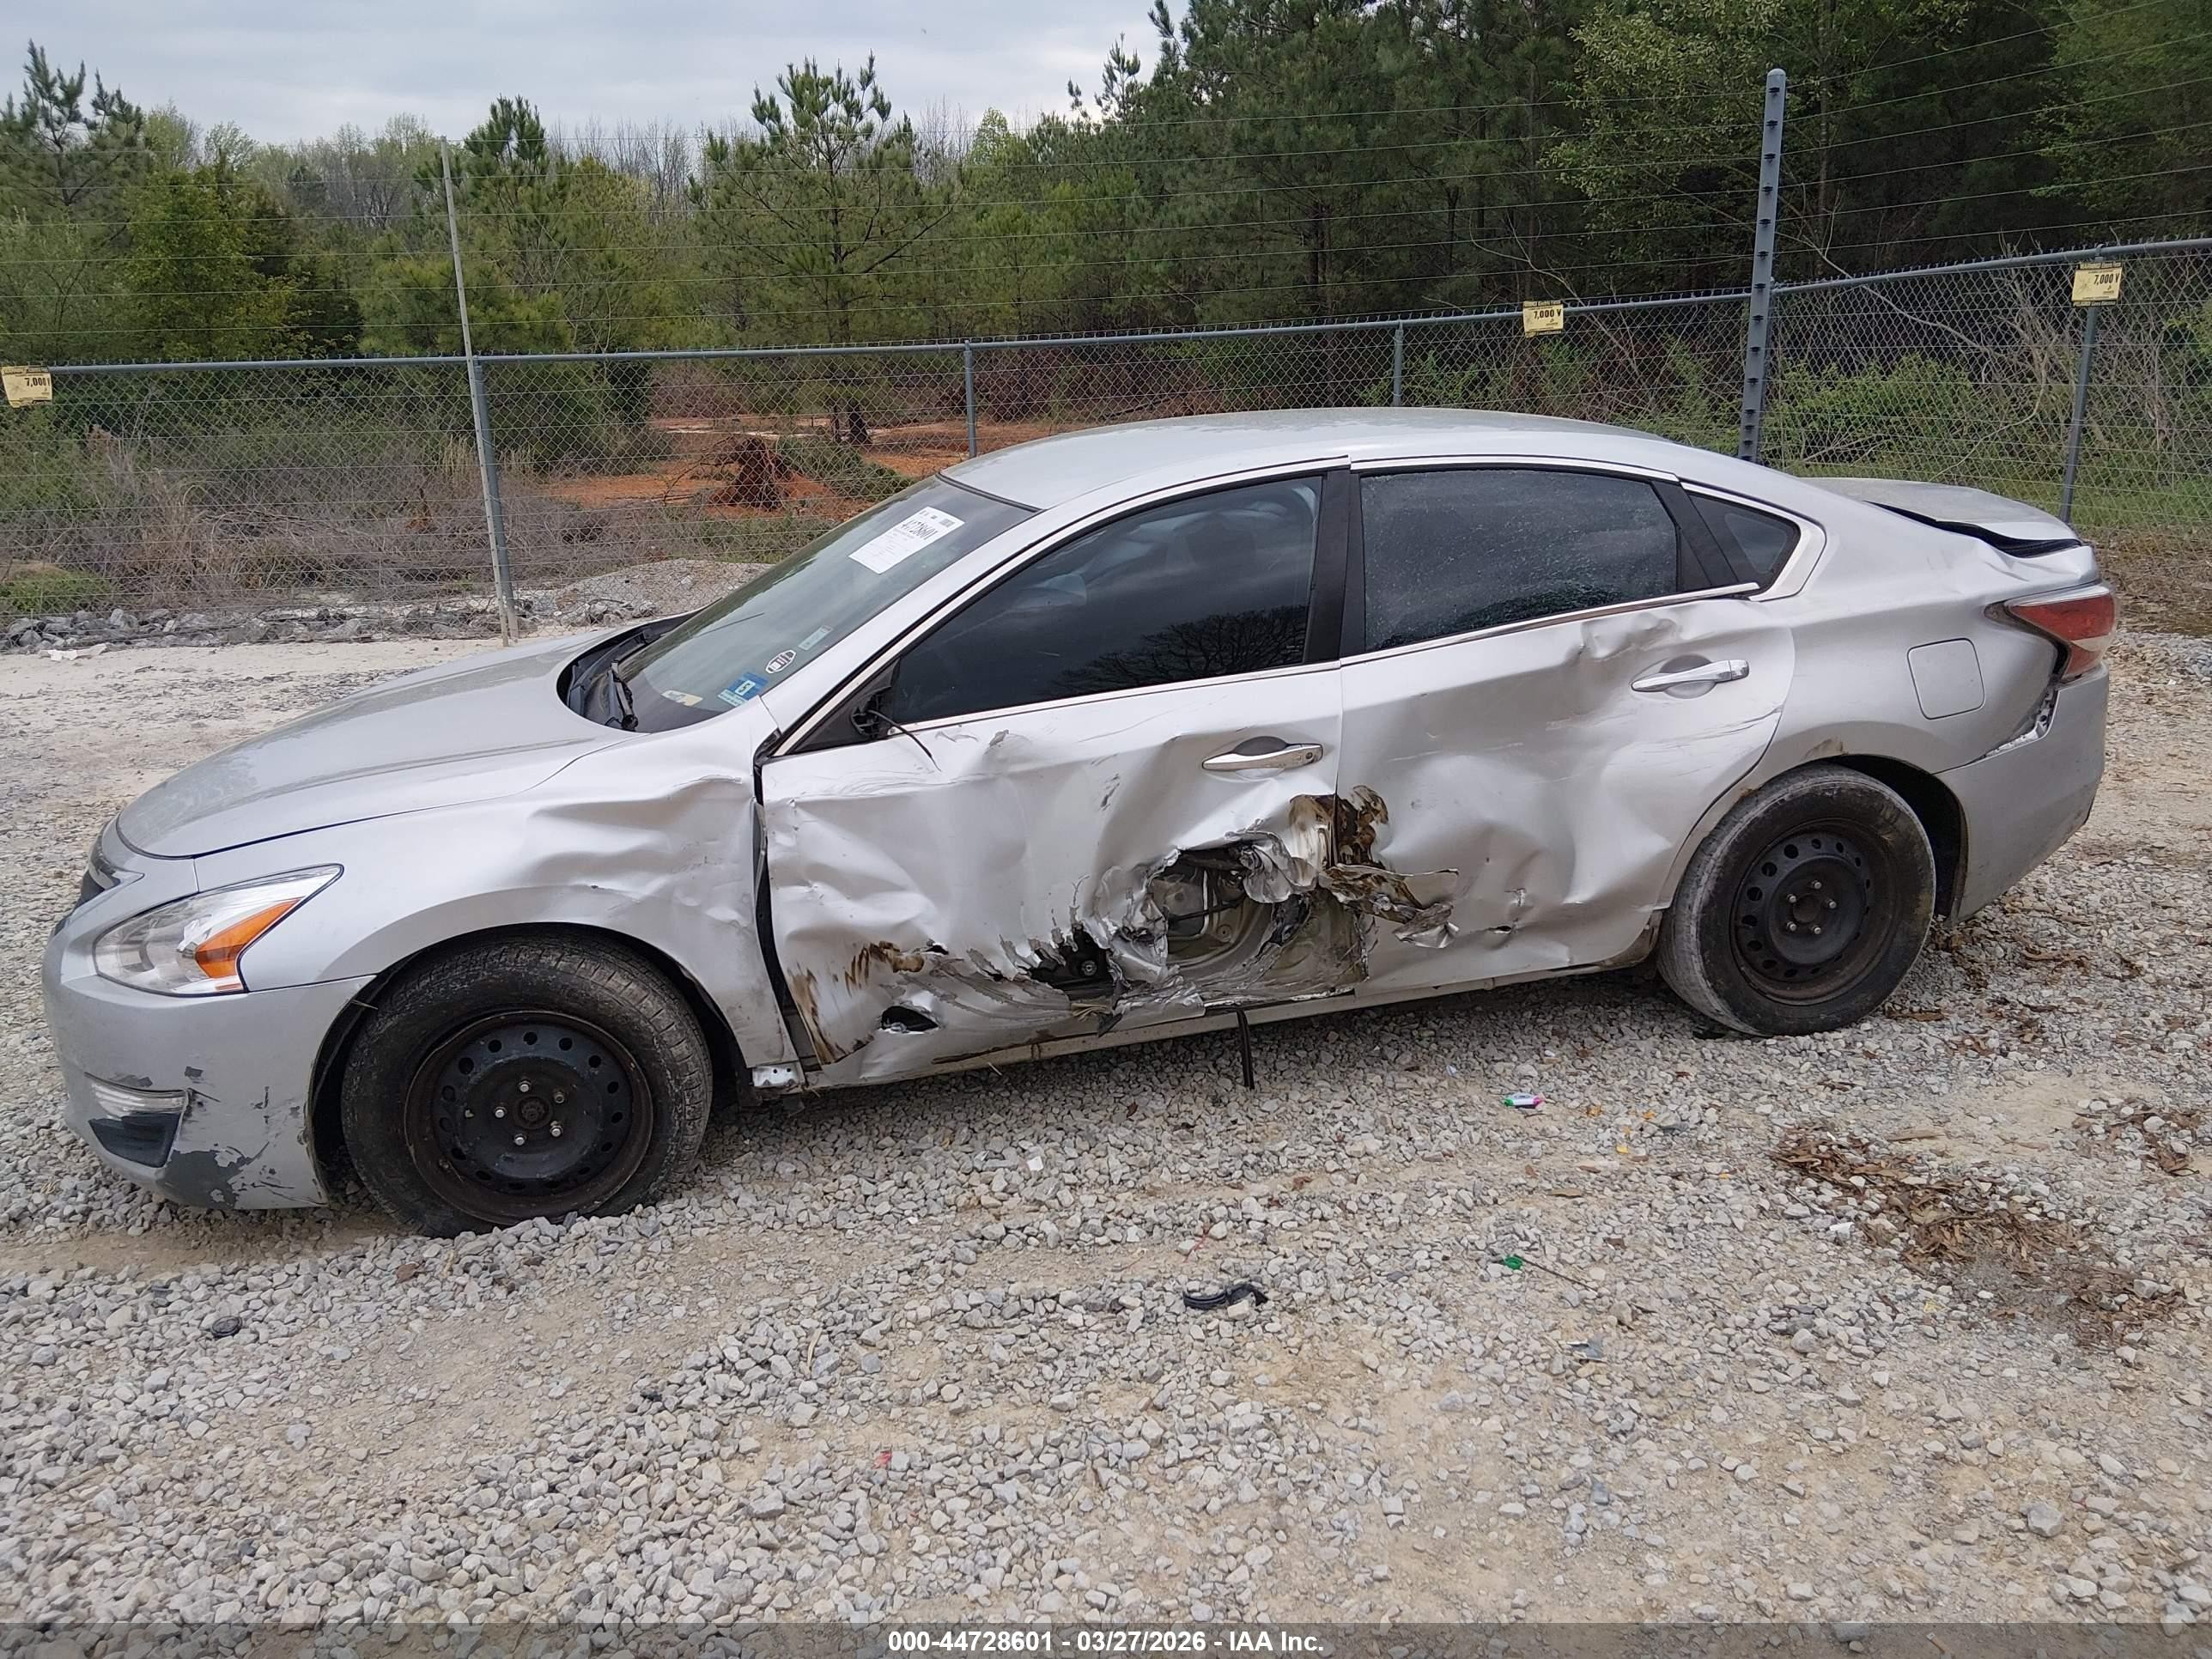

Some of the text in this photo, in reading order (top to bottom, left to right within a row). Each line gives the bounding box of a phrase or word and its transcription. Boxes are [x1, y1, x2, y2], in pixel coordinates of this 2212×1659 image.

[2094, 274, 2113, 285] 7,000
[1534, 308, 1562, 319] 7,000 V
